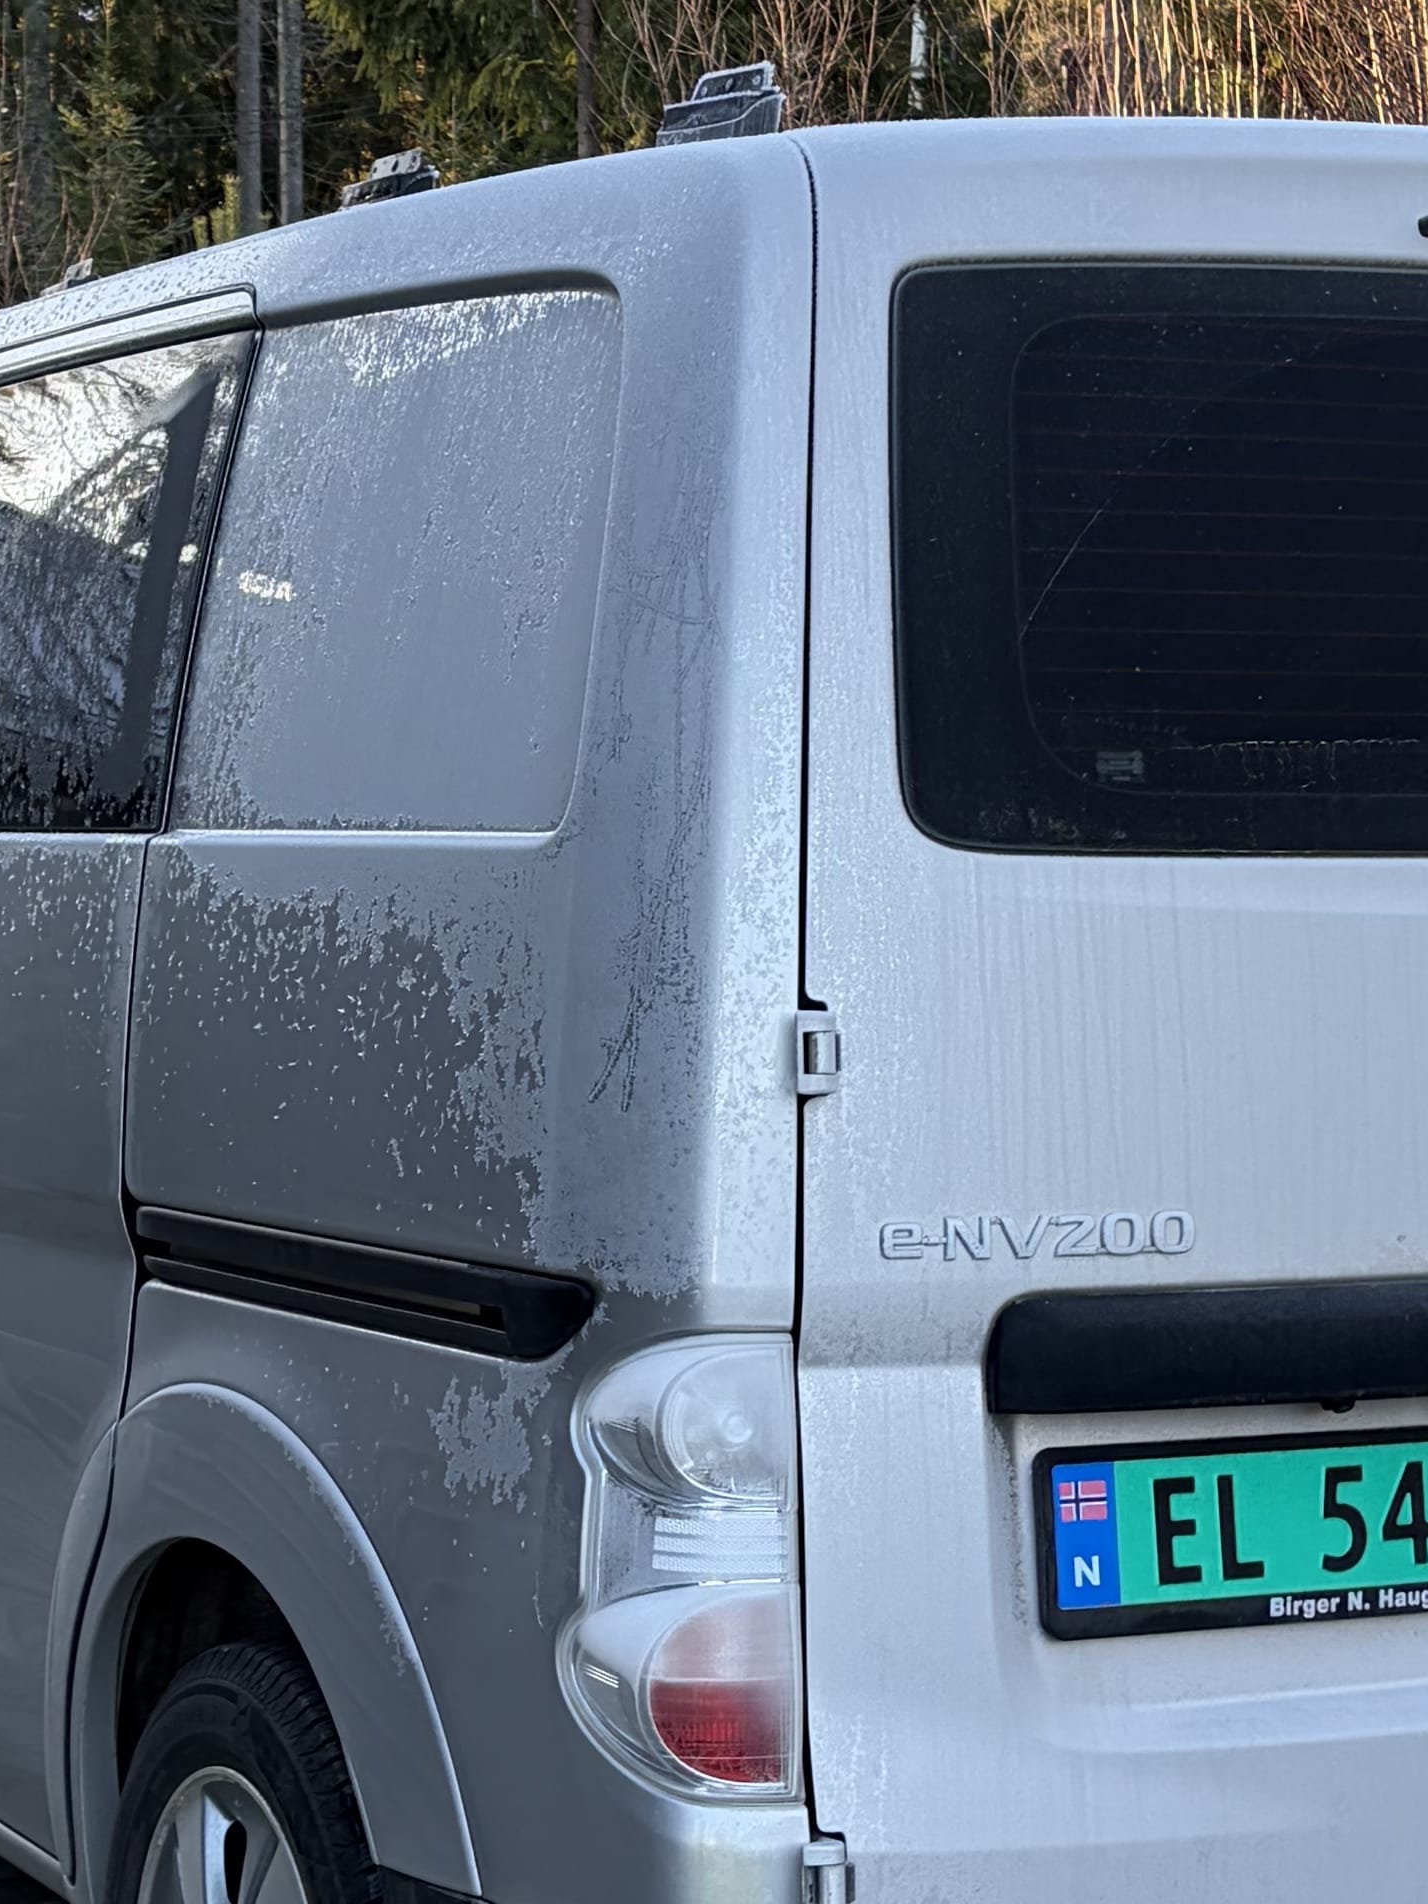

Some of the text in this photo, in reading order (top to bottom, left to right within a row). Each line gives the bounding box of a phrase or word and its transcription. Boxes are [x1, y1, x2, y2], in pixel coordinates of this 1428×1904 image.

[879, 1209, 1197, 1262] e-NV200
[1153, 1474, 1265, 1586] EL
[1074, 1555, 1101, 1588] N
[1269, 1596, 1341, 1619] Birger
[1347, 1590, 1371, 1612] N.
